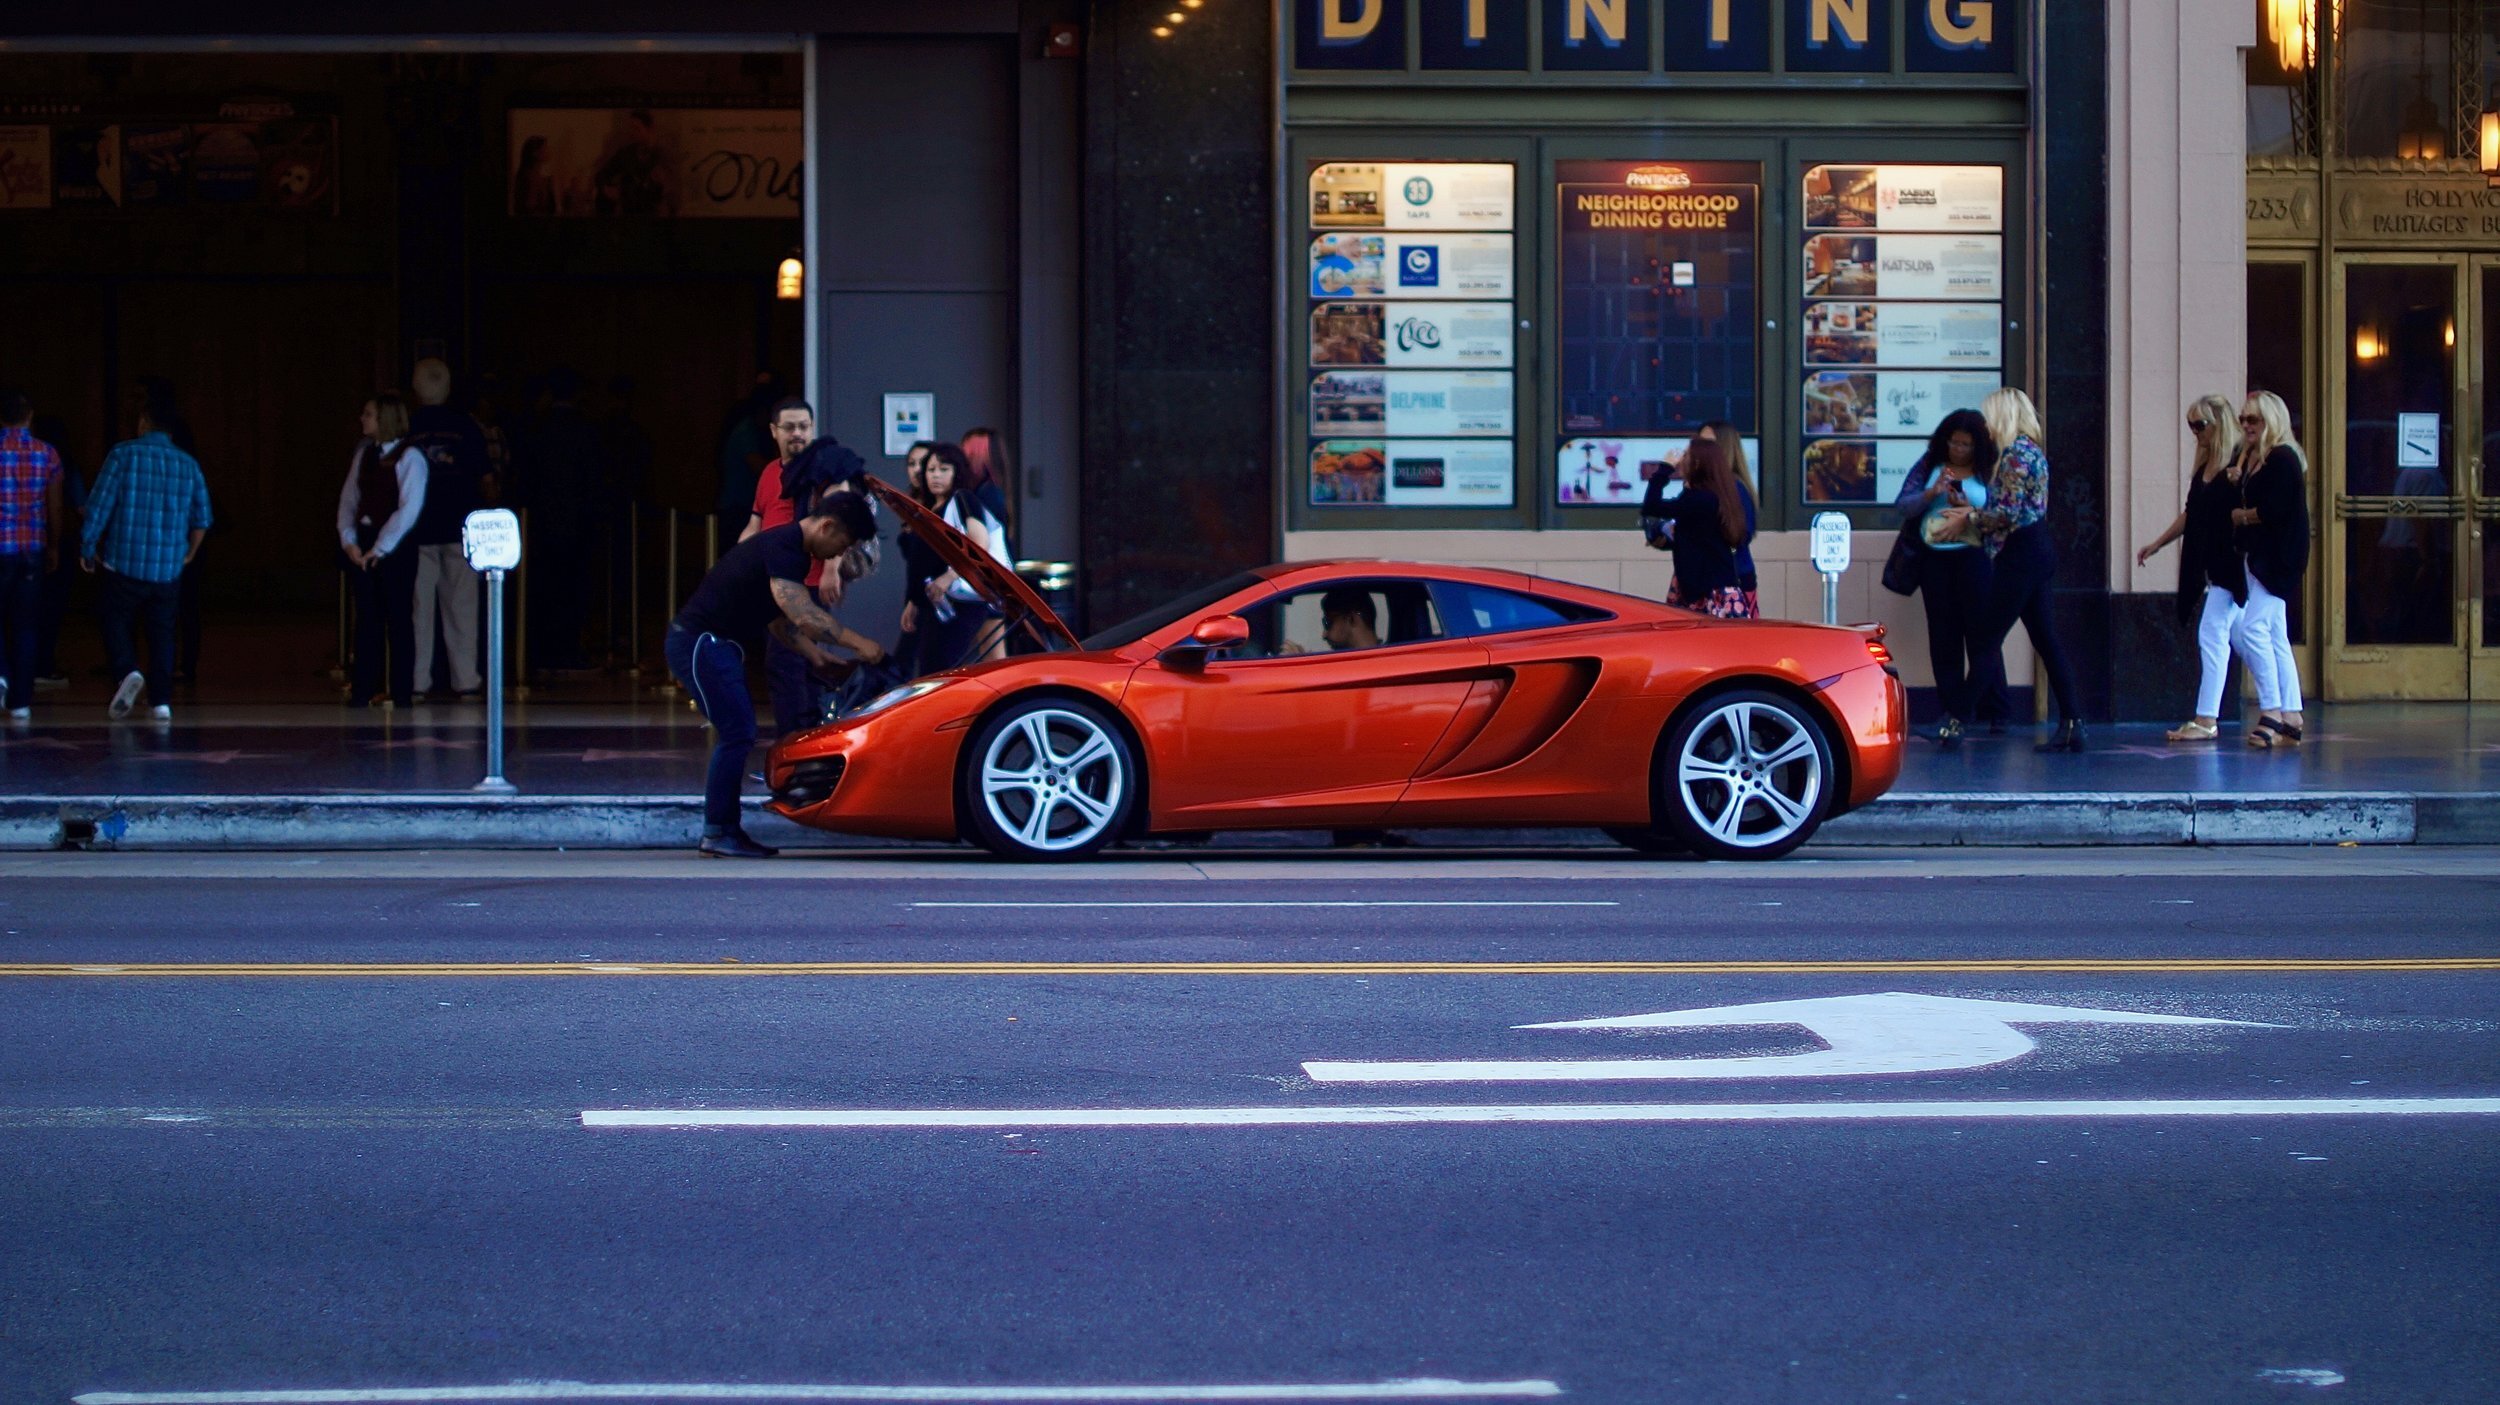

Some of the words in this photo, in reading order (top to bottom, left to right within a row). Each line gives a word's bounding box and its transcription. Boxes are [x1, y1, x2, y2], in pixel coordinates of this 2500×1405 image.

[1625, 172, 1691, 187] PANTAGES
[1408, 181, 1429, 201] 33
[1900, 189, 1936, 197] KABUKI
[1577, 194, 1739, 211] NEIGHBORHOOD
[2247, 198, 2288, 220] 233
[1406, 211, 1430, 219] TAPS
[1590, 212, 1663, 228] DINING
[1668, 212, 1727, 228] GUIDE
[2373, 214, 2468, 234] PANTAGES
[1882, 259, 1934, 271] KATSUYA
[1391, 391, 1446, 409] DELPHINE
[471, 519, 513, 530] PASSENGER
[1820, 521, 1848, 530] PASSENGER
[1823, 533, 1845, 543] LOADING
[1827, 545, 1839, 554] ONLY
